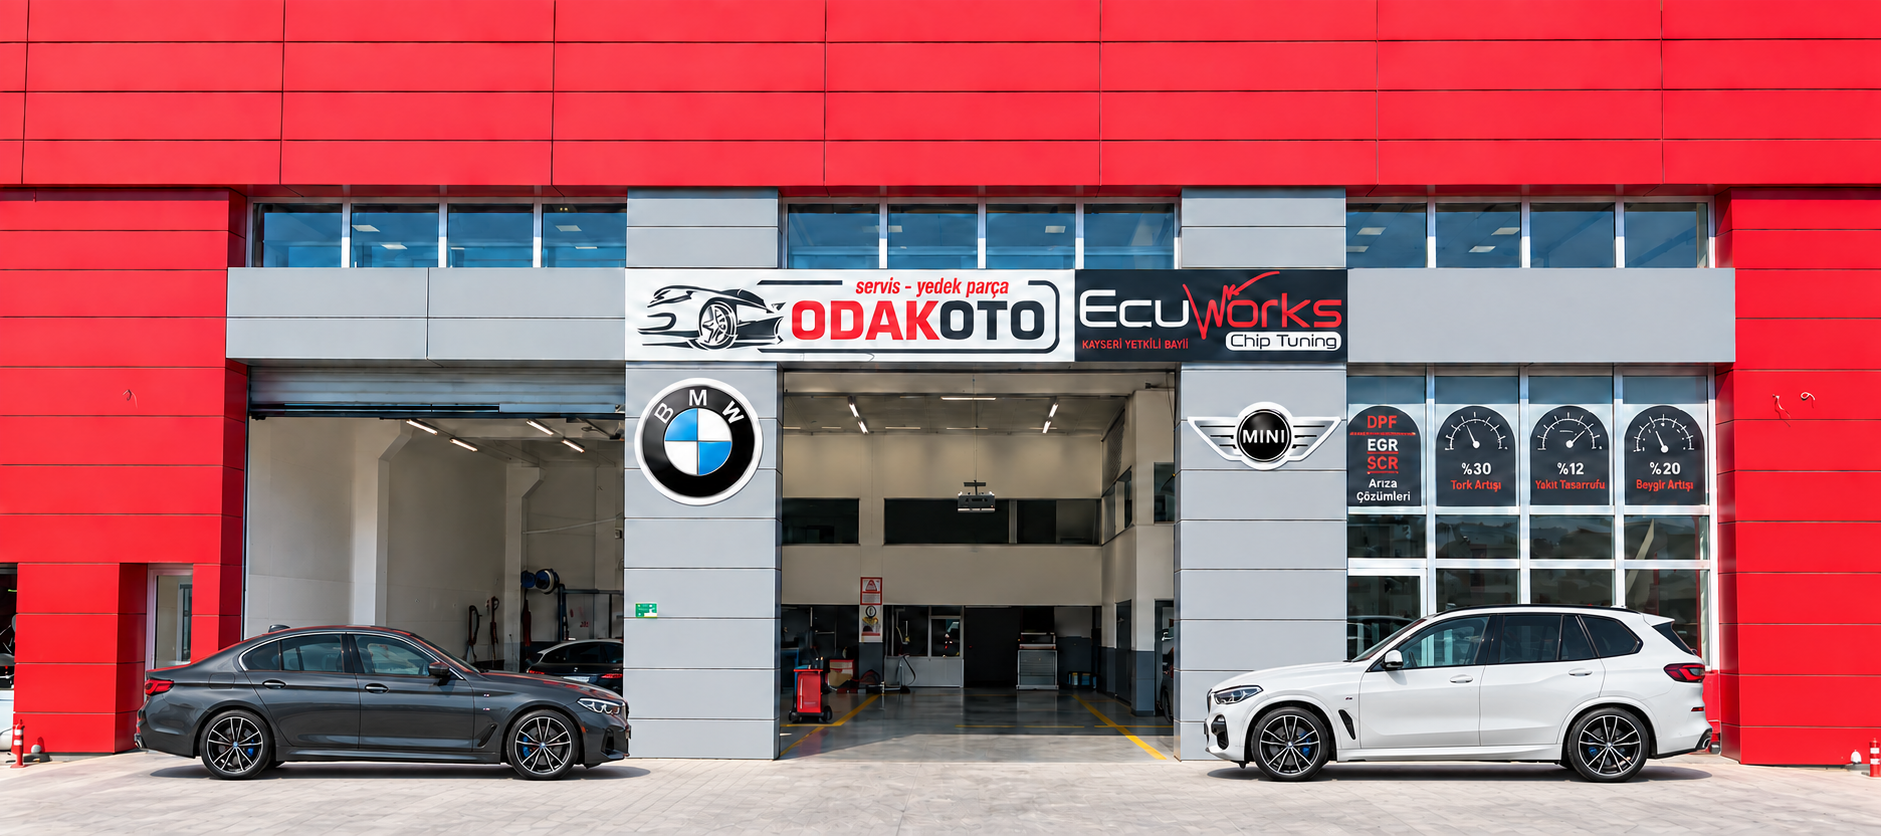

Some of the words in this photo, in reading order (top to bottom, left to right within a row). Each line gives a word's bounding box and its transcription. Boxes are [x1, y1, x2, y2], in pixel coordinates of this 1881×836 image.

[855, 277, 901, 294] servis
[916, 277, 962, 298] yedek
[965, 280, 1010, 299] parça
[1082, 337, 1122, 350] KAYSERİ
[1124, 337, 1162, 350] YETKİLİ
[1164, 338, 1189, 350] BAYİİ
[1230, 334, 1271, 349] Chip
[1276, 334, 1338, 349] Tuning
[654, 389, 745, 424] BMW
[1367, 415, 1398, 429] DPF
[1242, 429, 1285, 444] MINI
[1367, 438, 1399, 452] EGR
[1367, 455, 1399, 470] SCR
[1461, 462, 1492, 475] %30
[1556, 462, 1585, 475] %12
[1649, 461, 1681, 475] %20
[1368, 478, 1398, 488] Arıza
[1450, 479, 1473, 490] Tork
[1474, 479, 1502, 493] Artışı
[1559, 478, 1606, 490] Tasarrufu
[1667, 479, 1694, 493] Artışı
[1356, 490, 1411, 503] Çözümleri
